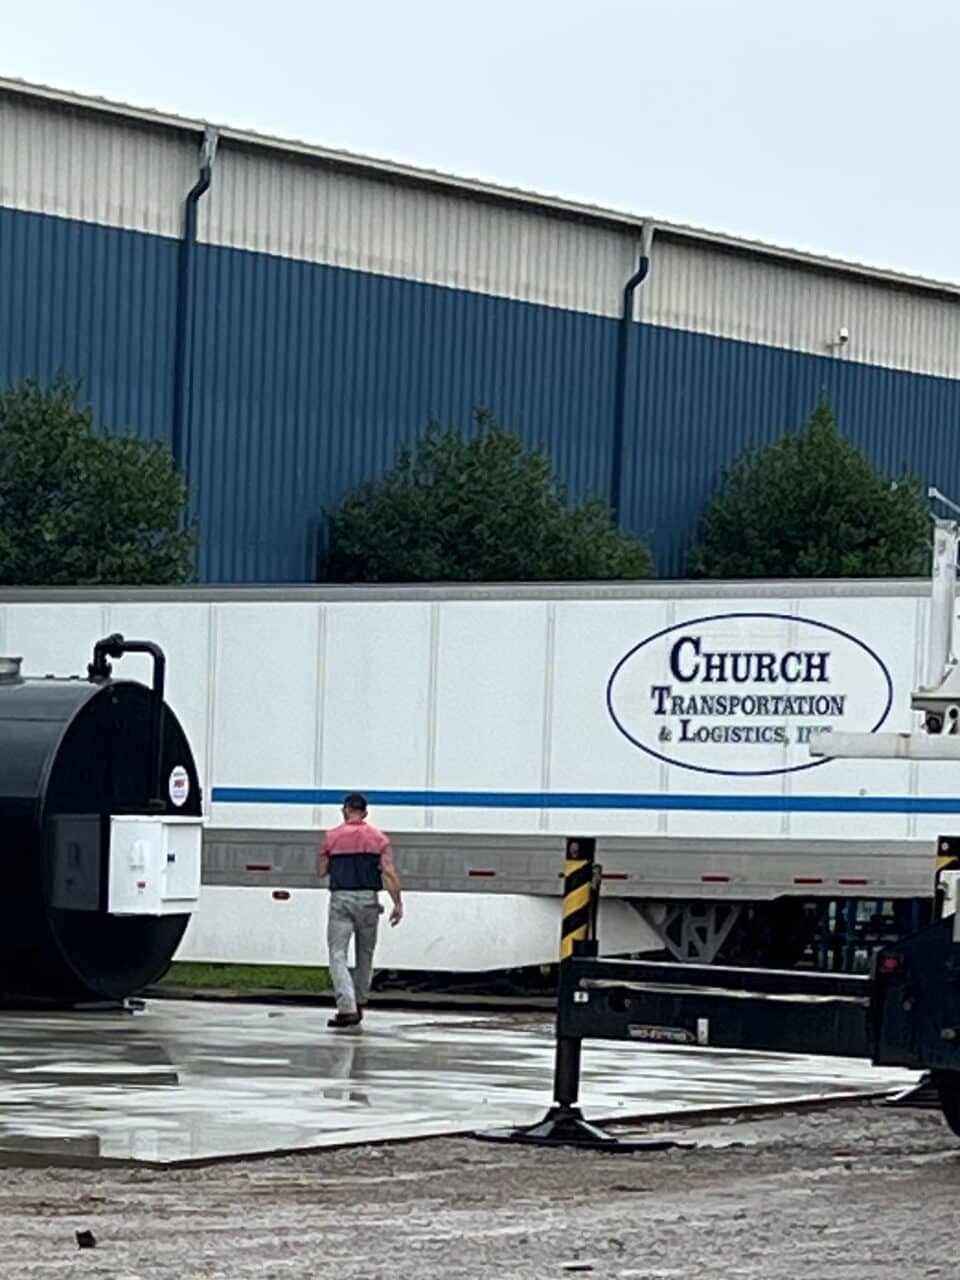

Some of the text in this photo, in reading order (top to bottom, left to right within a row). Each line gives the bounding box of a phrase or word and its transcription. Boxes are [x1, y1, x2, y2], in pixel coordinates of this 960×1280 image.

[670, 636, 830, 683] CHURCH
[651, 685, 846, 716] TRANSPORTATION
[658, 725, 672, 743] &
[679, 719, 789, 747] LOGISTICS,
